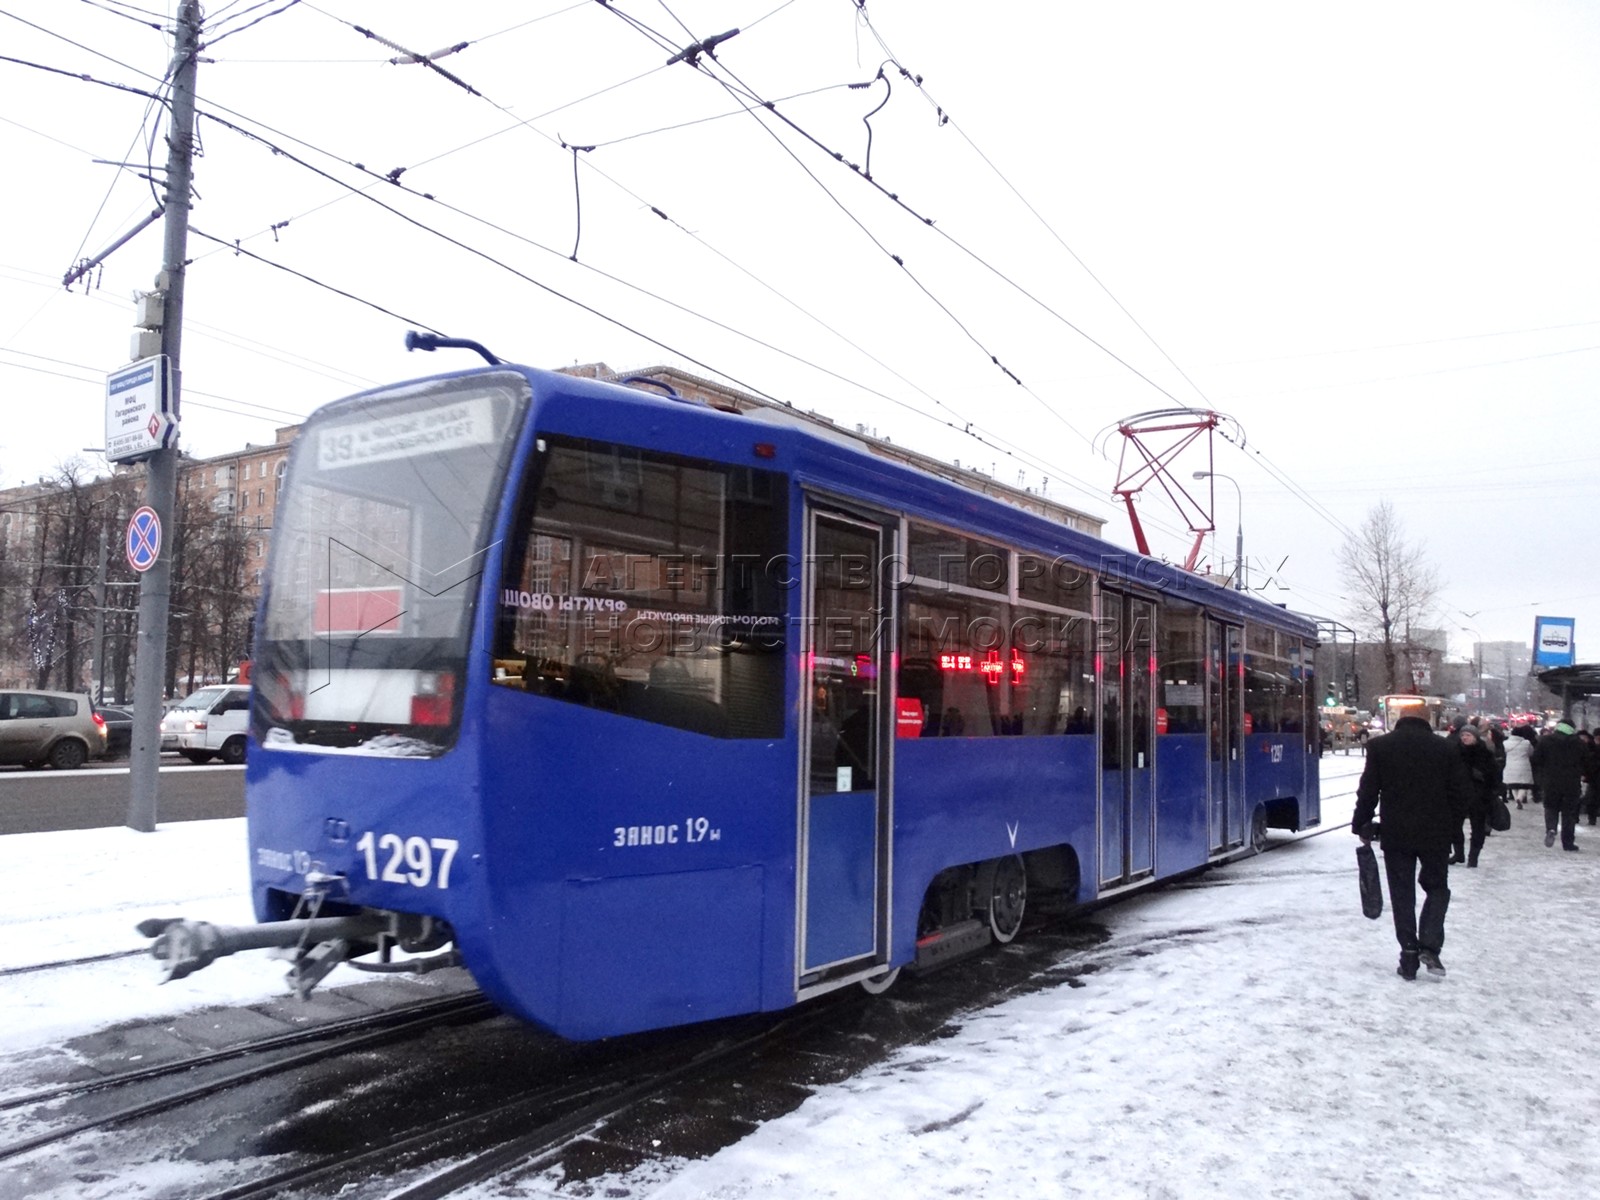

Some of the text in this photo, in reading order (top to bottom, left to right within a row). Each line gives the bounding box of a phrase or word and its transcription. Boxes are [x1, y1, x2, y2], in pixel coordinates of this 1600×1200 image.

[115, 403, 147, 418] Гагаринского
[125, 394, 137, 405] МФЦ
[323, 433, 353, 463] 39
[613, 824, 679, 847] ЗАНОС
[356, 831, 459, 889] 1297
